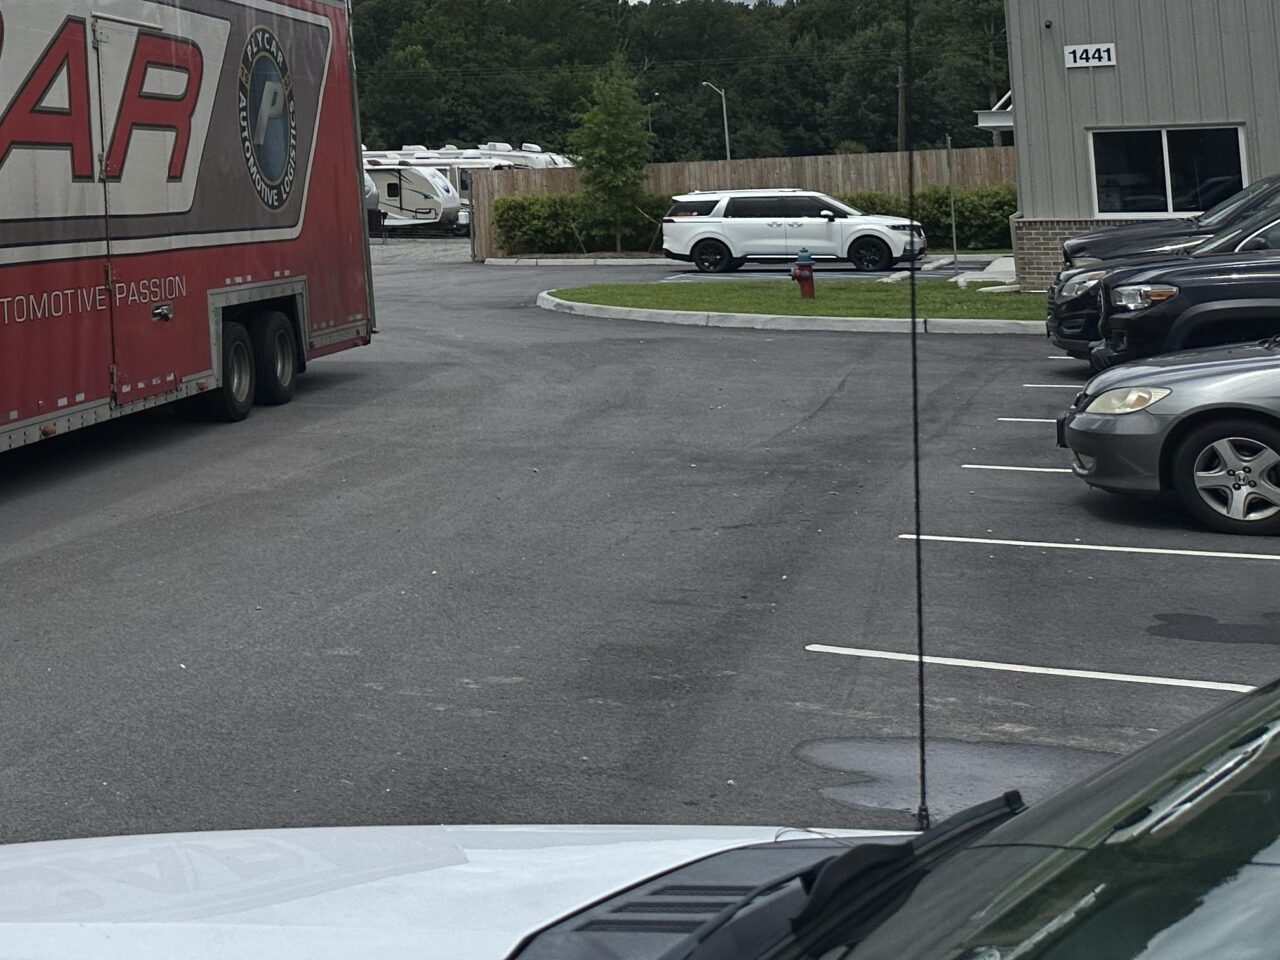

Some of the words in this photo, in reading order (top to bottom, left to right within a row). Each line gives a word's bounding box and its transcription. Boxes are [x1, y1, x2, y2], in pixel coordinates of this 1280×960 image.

[247, 32, 283, 67] PLYCAR
[1068, 48, 1112, 63] 1441
[239, 92, 278, 206] AUTOMOTIVE
[281, 101, 296, 200] LOGISTICS
[115, 275, 187, 307] PASSION
